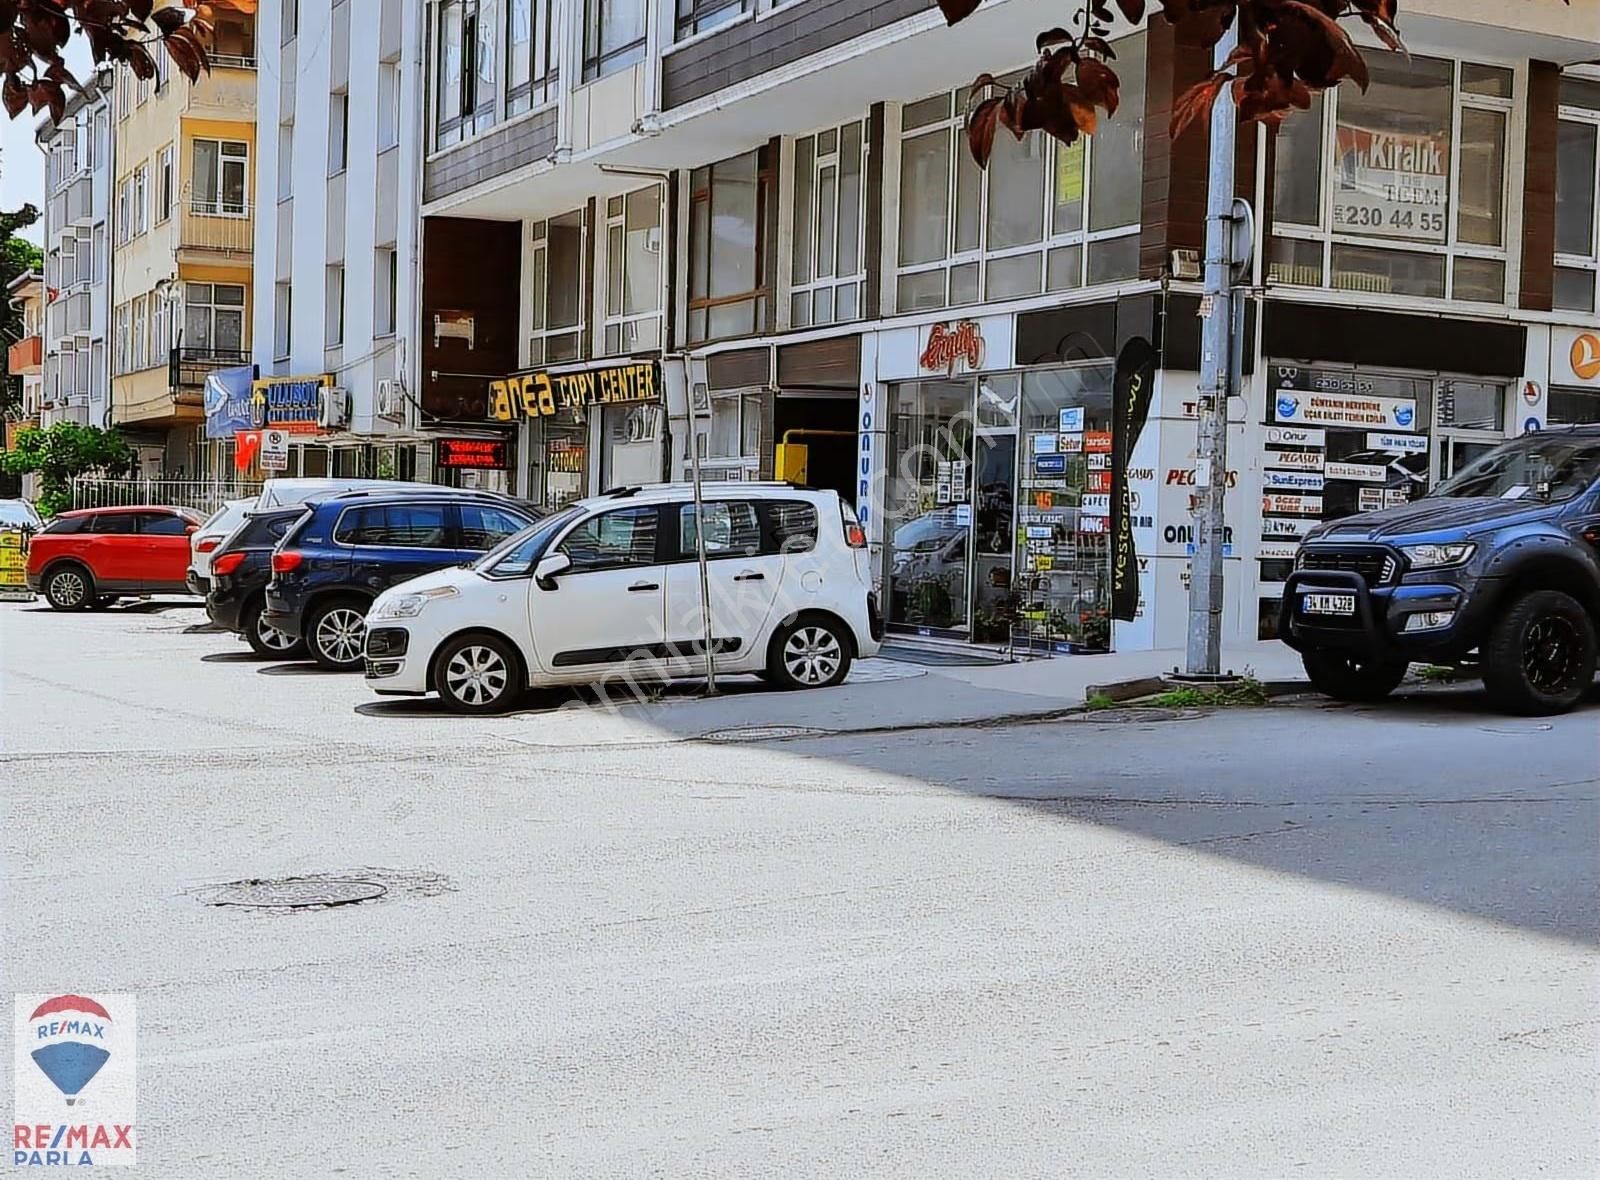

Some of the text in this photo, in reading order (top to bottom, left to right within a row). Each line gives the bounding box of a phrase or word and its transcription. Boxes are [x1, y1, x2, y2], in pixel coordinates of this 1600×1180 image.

[1346, 206, 1443, 231] 230 44 55
[559, 373, 595, 407] COPY
[599, 365, 655, 402] CENTER
[1283, 430, 1307, 441] Onur
[1279, 452, 1319, 464] PEGASUS
